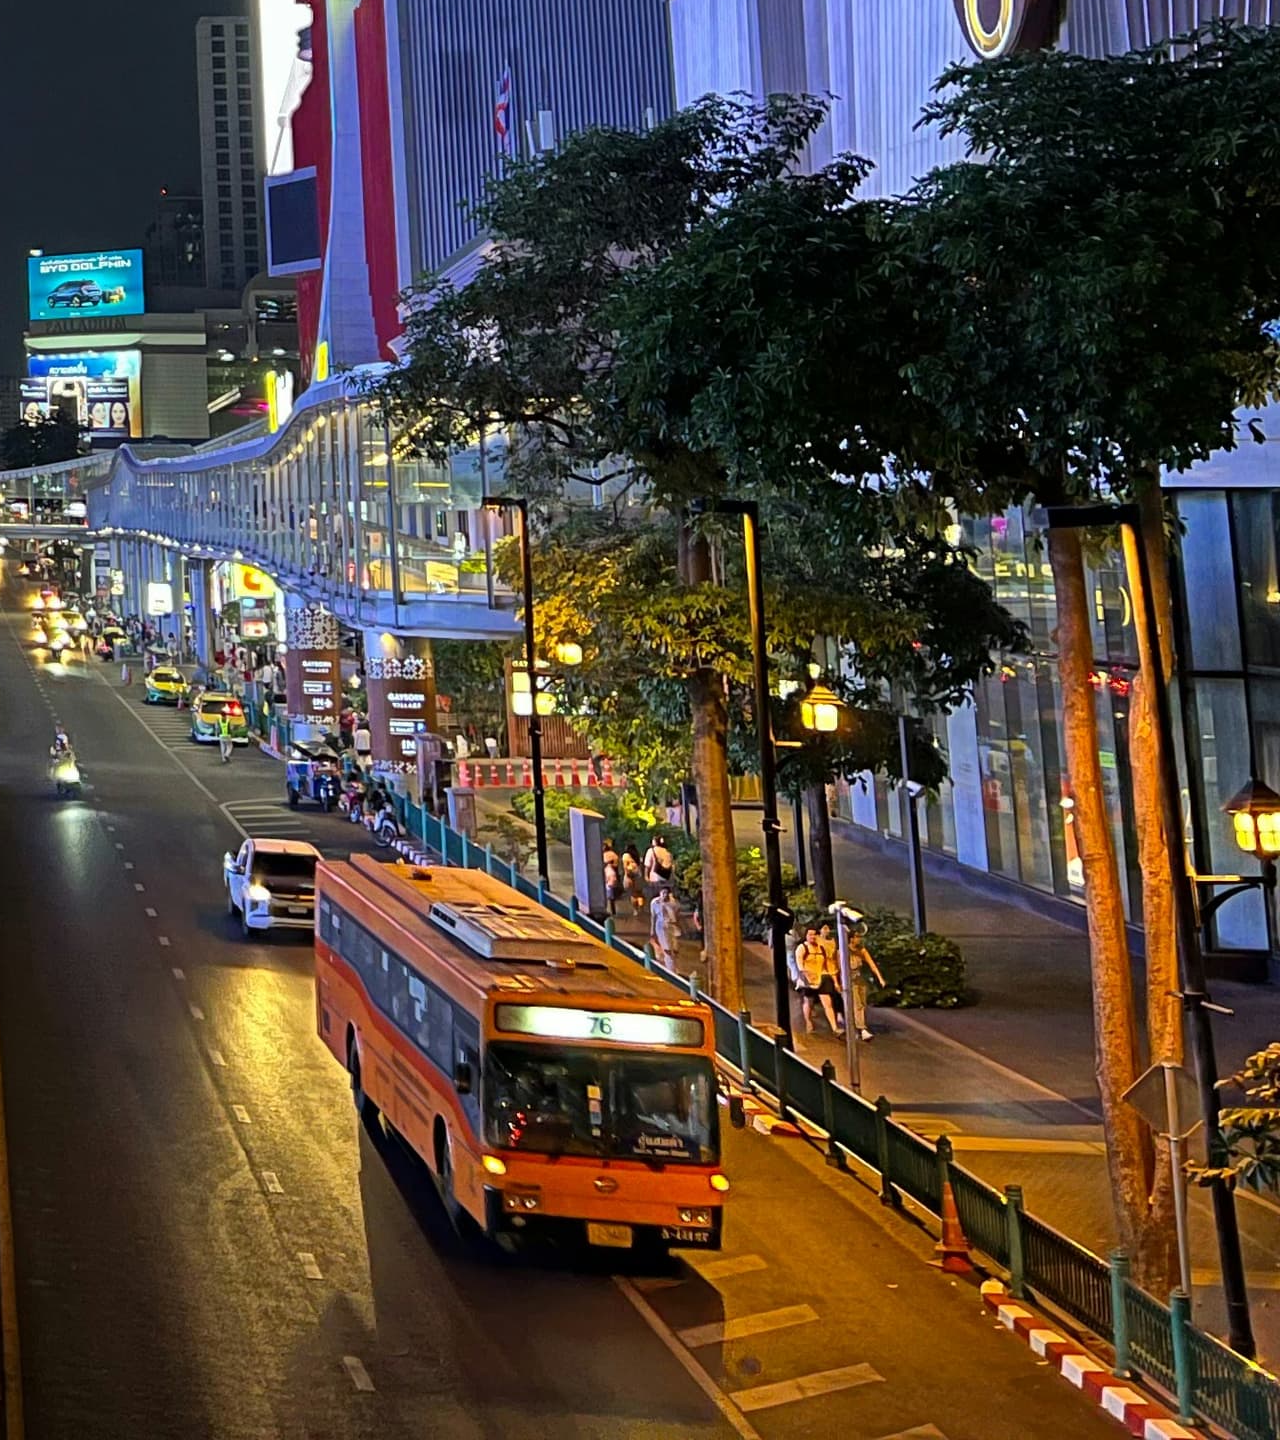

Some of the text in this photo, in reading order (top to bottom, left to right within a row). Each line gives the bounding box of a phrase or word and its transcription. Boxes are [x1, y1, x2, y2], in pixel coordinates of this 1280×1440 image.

[40, 265, 68, 273] BYD
[70, 259, 132, 272] DOLPHIN
[387, 693, 425, 702] GAYSORN
[587, 1016, 612, 1035] 76
